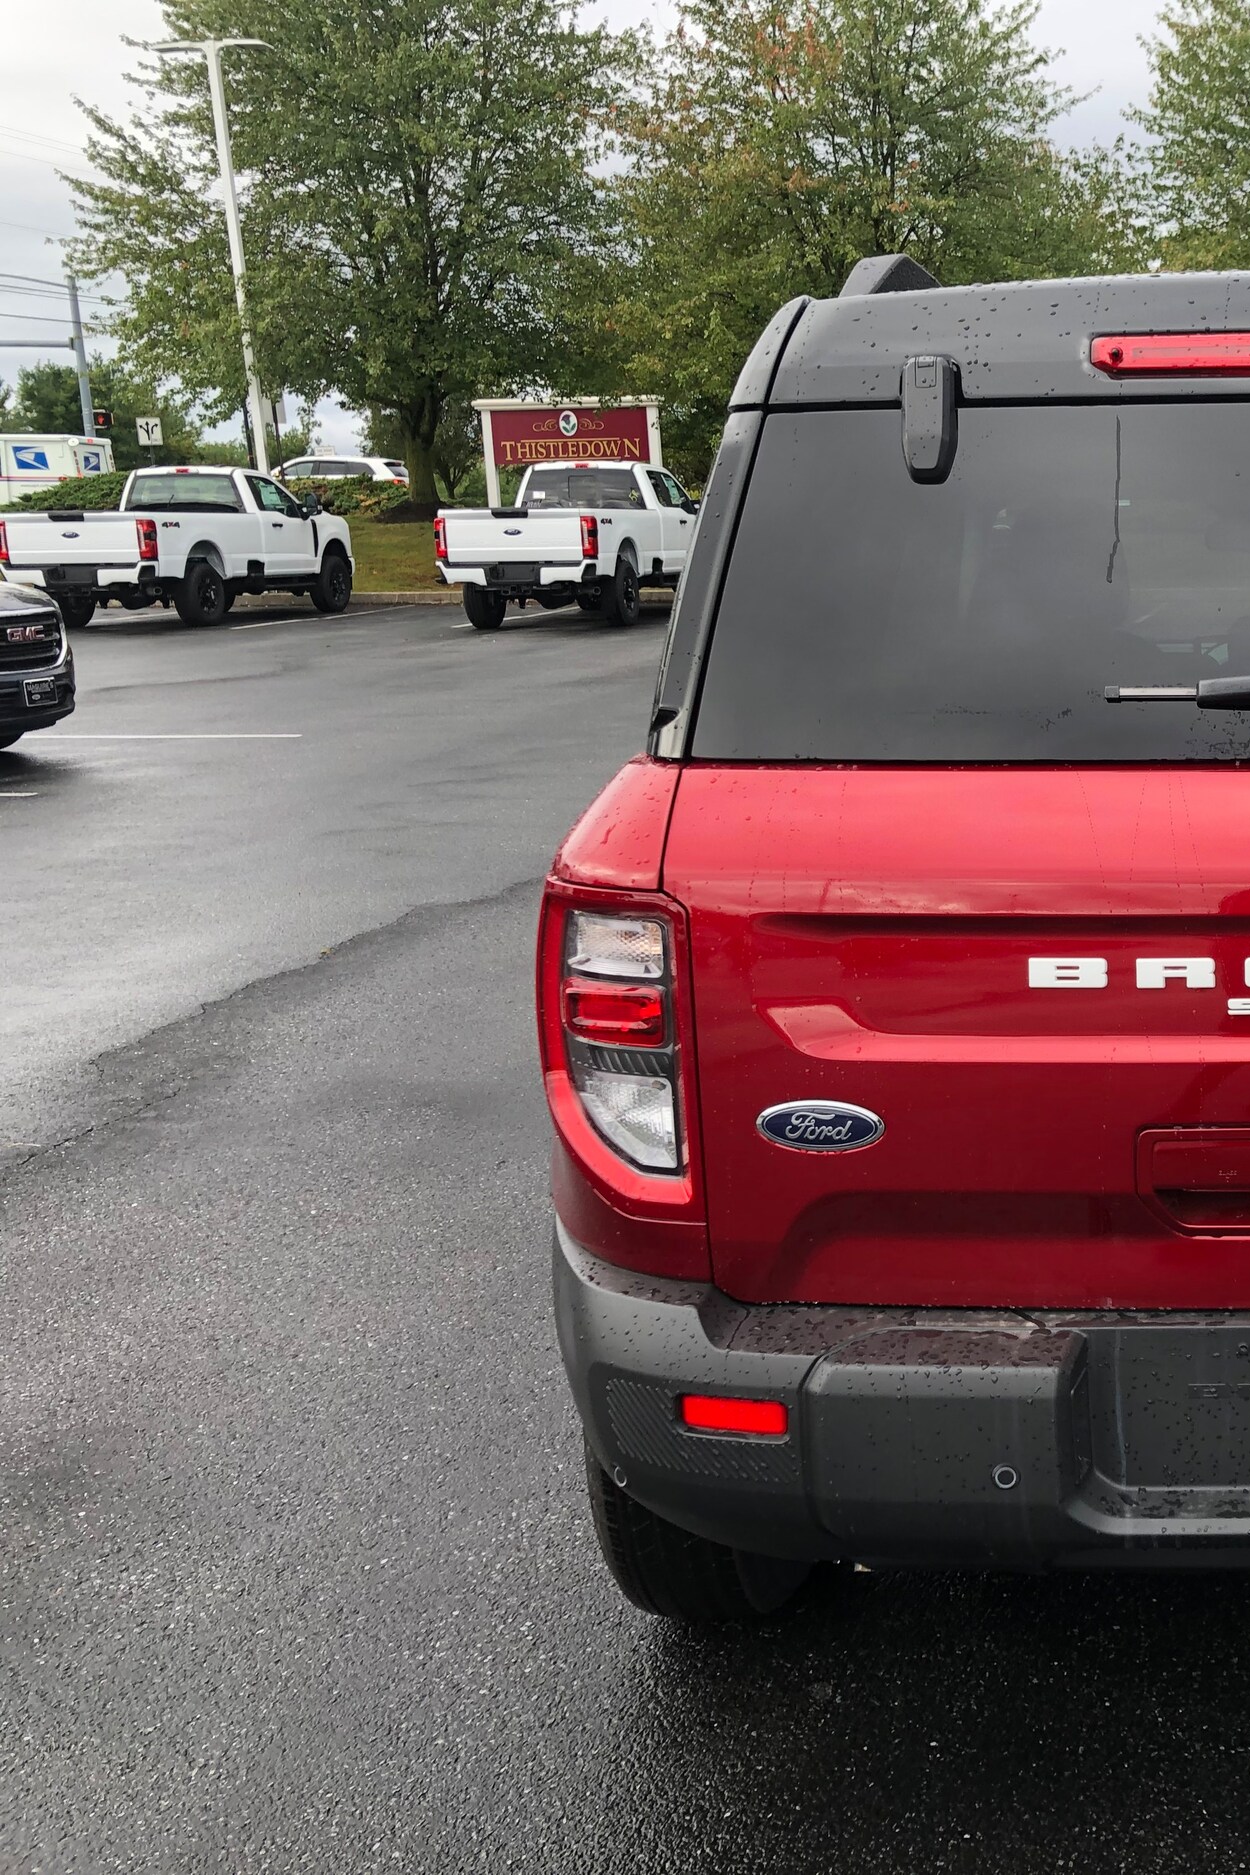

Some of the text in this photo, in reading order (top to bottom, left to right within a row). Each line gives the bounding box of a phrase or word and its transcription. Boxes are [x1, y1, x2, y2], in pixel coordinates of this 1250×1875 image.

[501, 438, 640, 461] THISTLEDOWN
[7, 625, 45, 641] GMC
[785, 1111, 852, 1140] Ford
